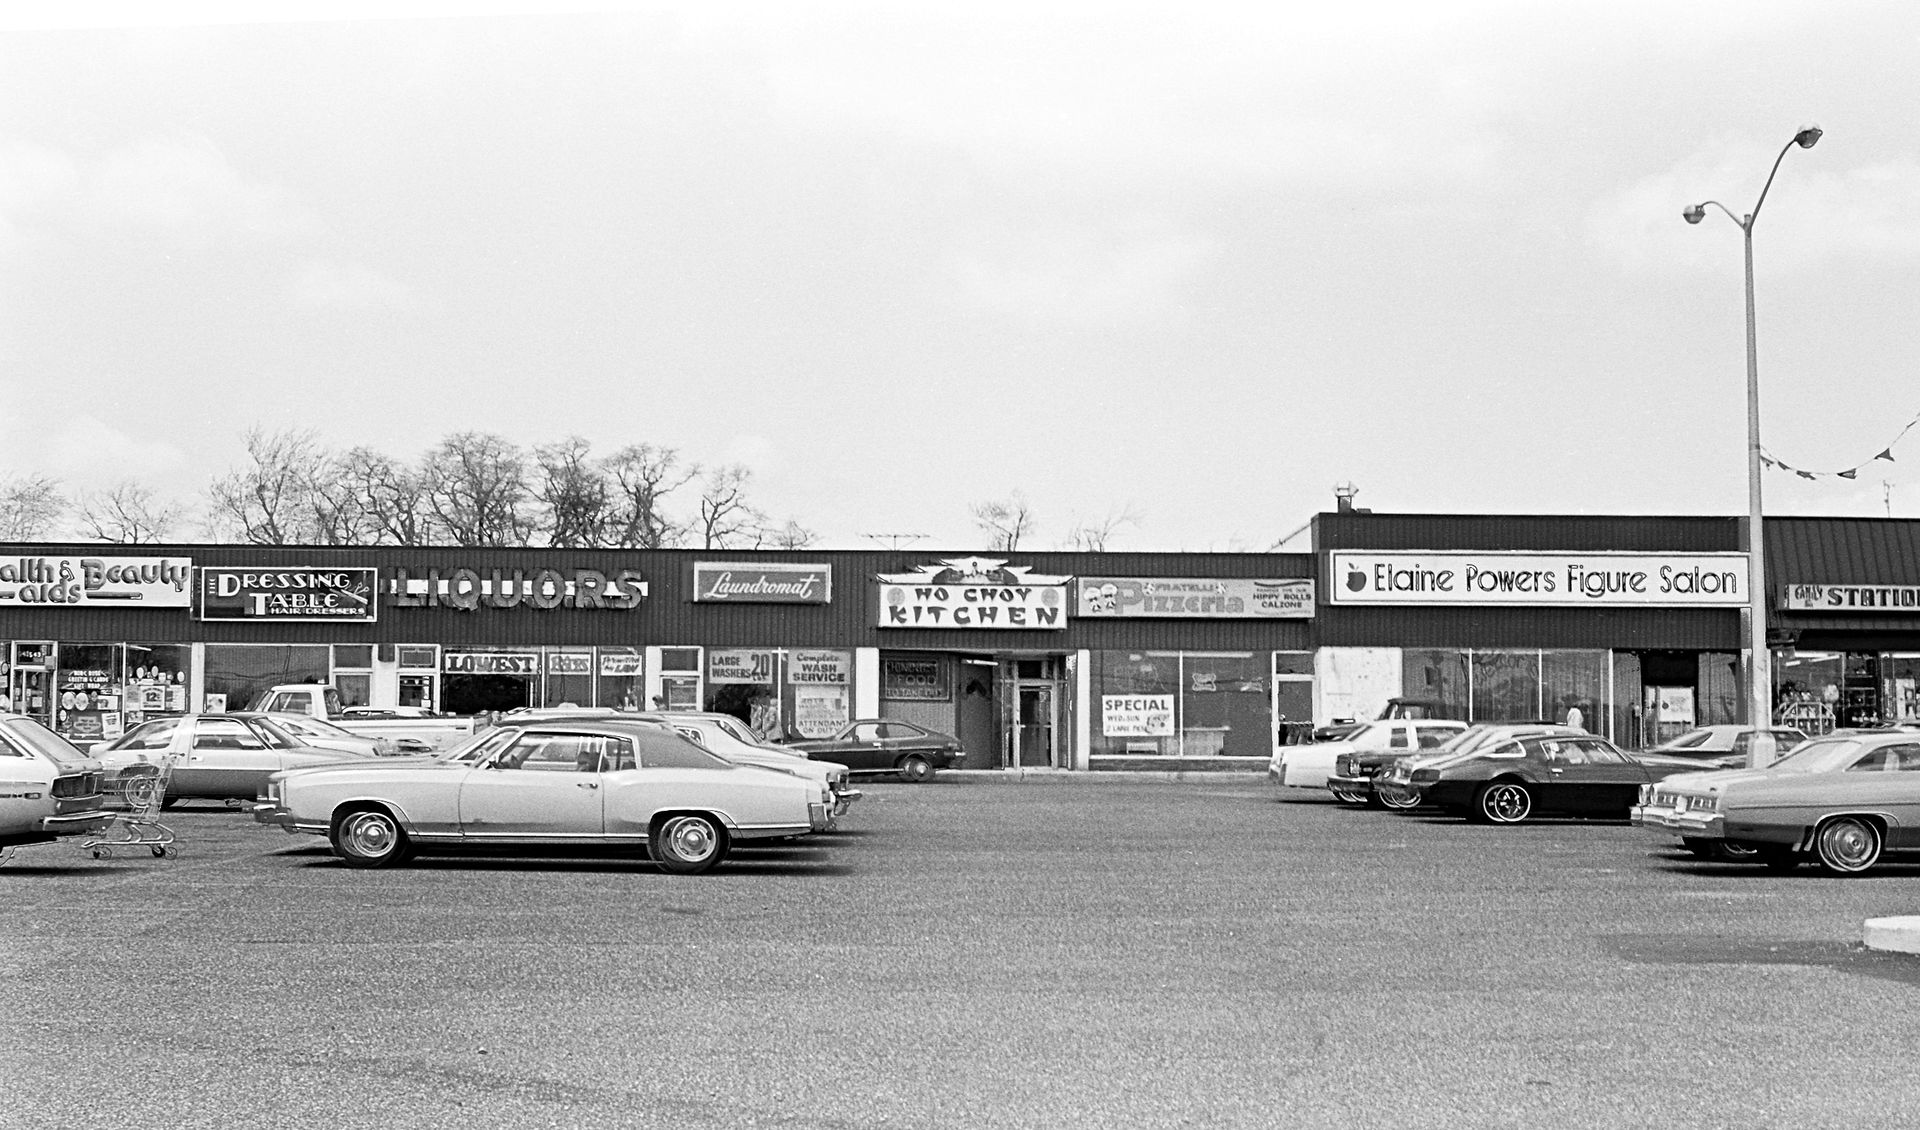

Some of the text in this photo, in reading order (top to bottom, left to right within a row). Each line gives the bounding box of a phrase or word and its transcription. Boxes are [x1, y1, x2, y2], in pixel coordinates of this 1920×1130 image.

[60, 560, 75, 580] &
[80, 559, 189, 592] Beauty
[218, 573, 351, 597] DRESSING
[1374, 563, 1737, 598] Elaine Powers Figure Salon
[388, 568, 643, 611] LIQUORS
[703, 572, 820, 599] Laundromat
[915, 588, 1032, 602] HO CHOY
[249, 592, 339, 615] TABLE
[1083, 580, 1244, 614] Pizzeria
[1827, 587, 1920, 607] STATIO
[889, 606, 1058, 625] KITCHEN
[448, 655, 536, 673] LOWEST
[712, 656, 740, 665] LARGE
[751, 654, 769, 676] 20
[797, 653, 840, 663] Complete
[712, 668, 751, 678] WASHERS
[793, 673, 845, 682] SERVICE
[802, 664, 837, 672] WASH
[1105, 699, 1169, 711] SPECIAL
